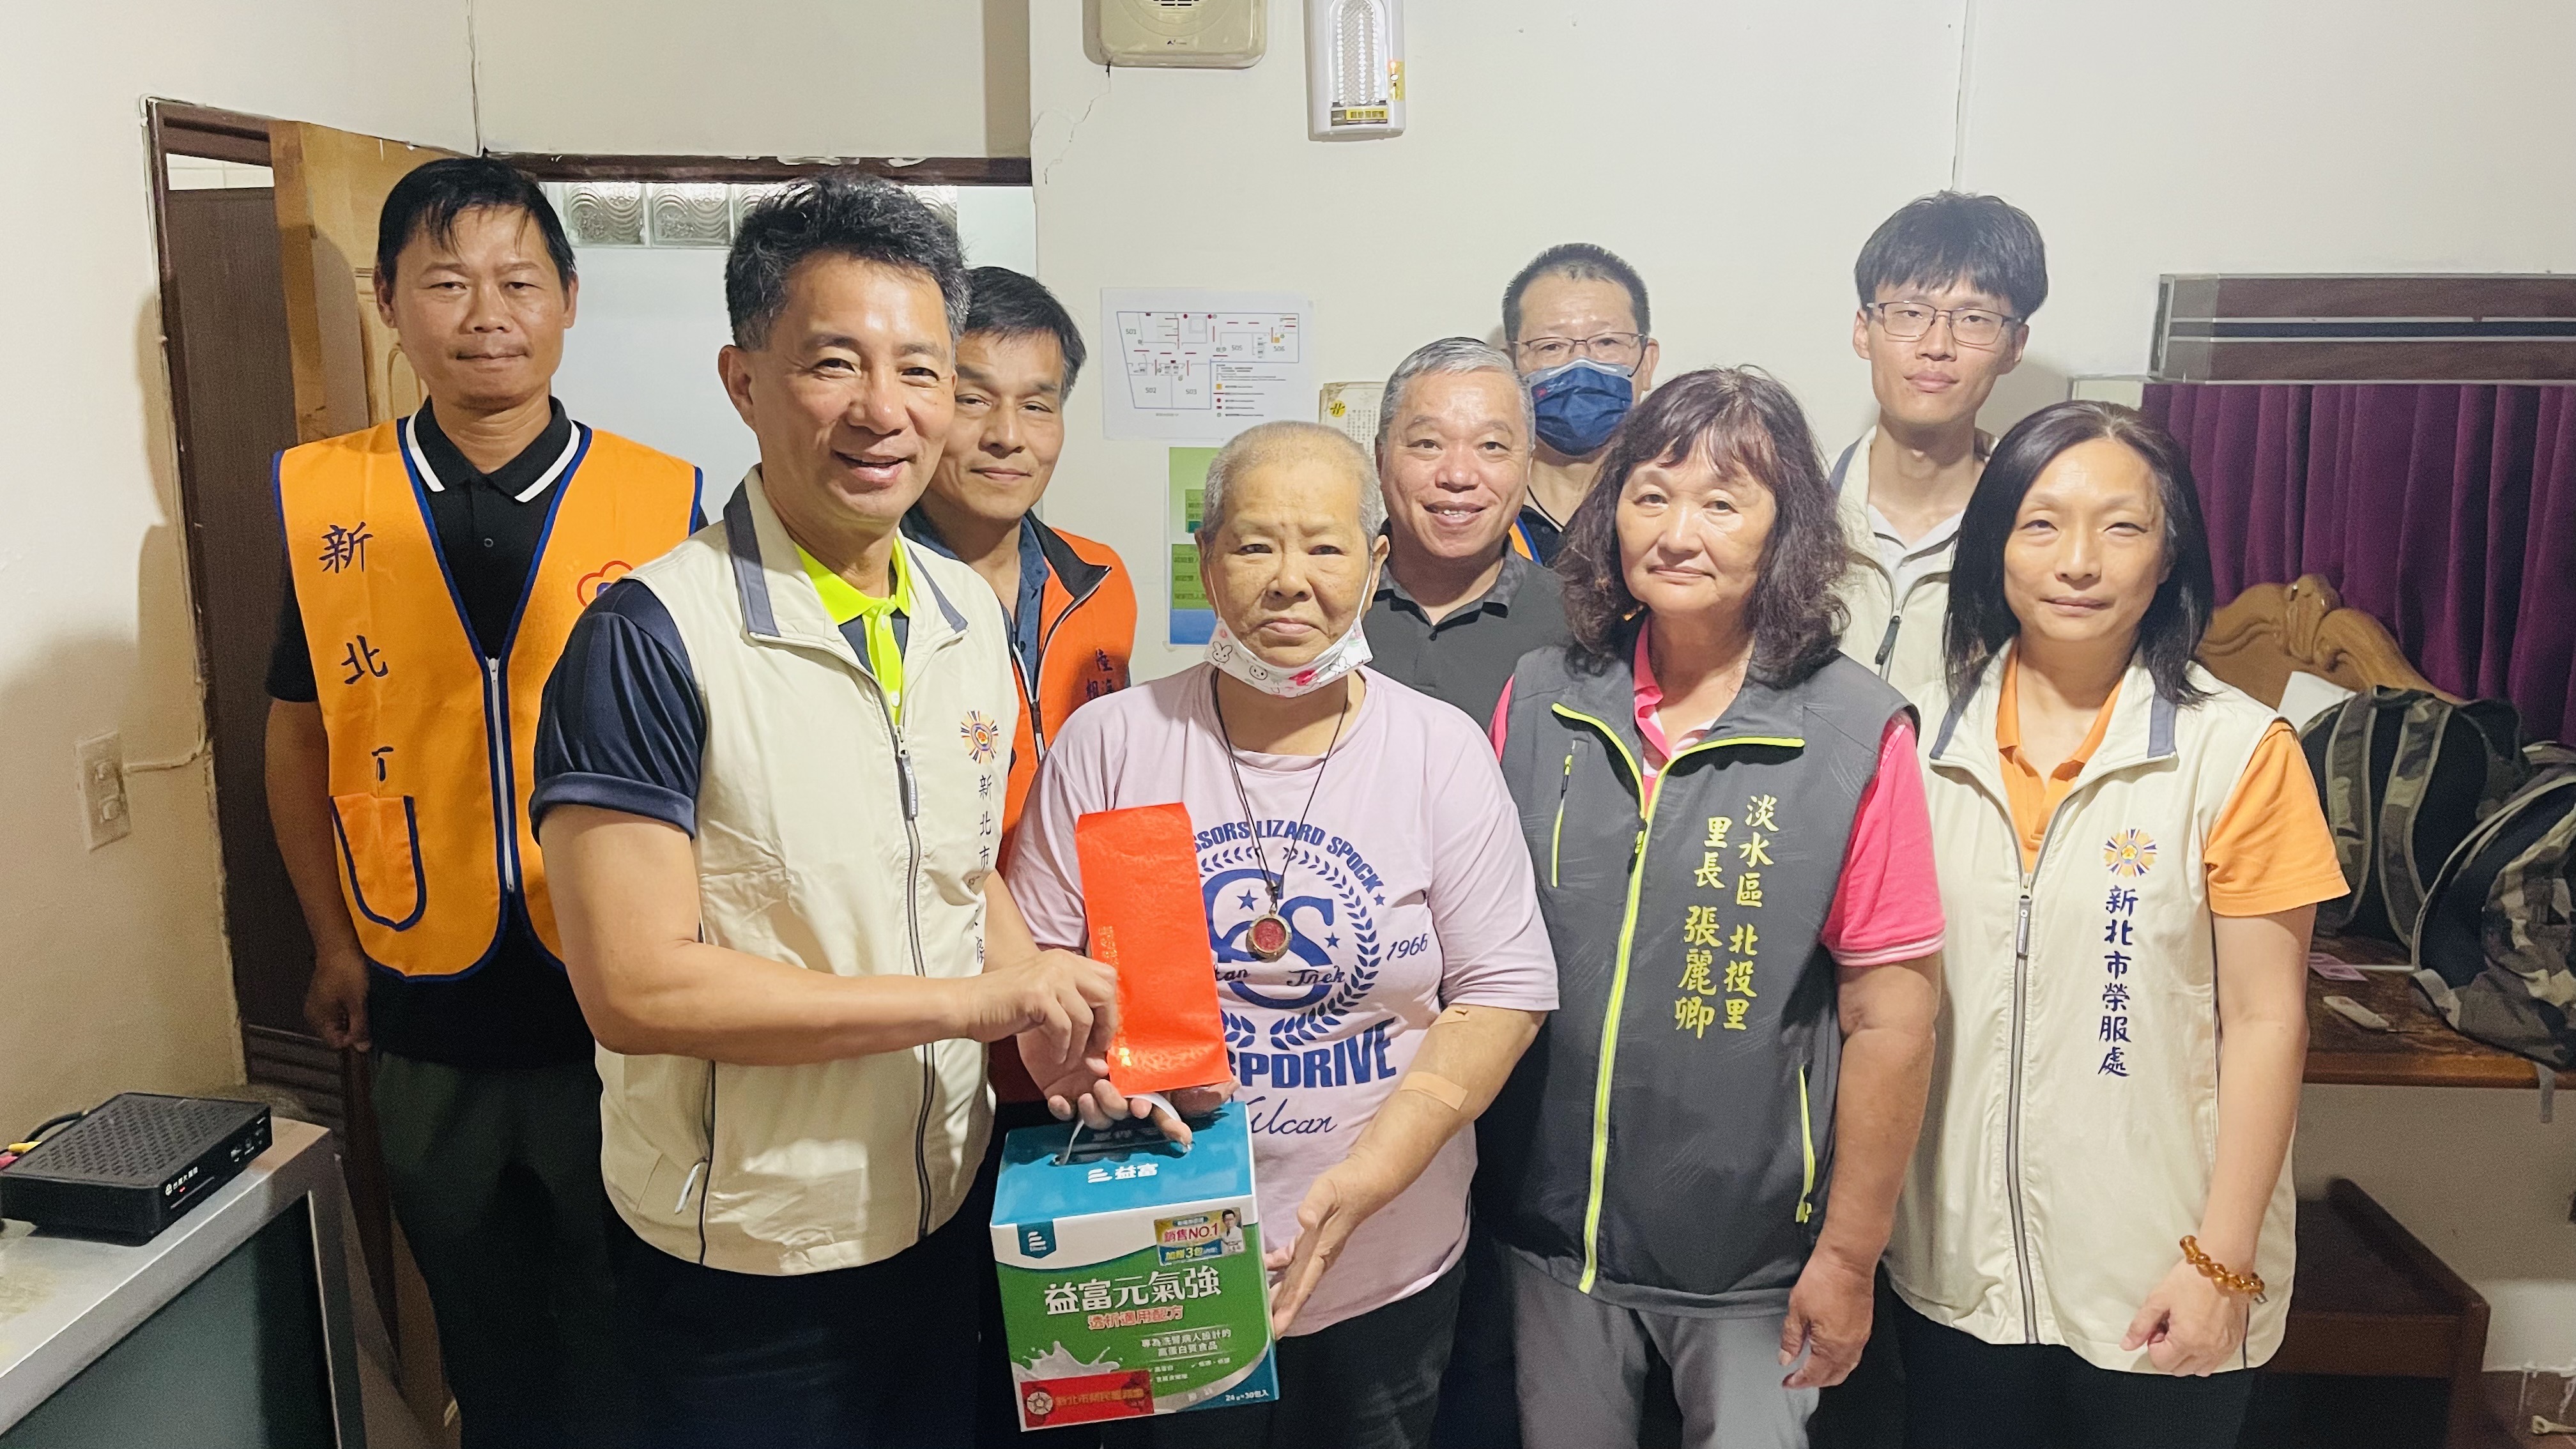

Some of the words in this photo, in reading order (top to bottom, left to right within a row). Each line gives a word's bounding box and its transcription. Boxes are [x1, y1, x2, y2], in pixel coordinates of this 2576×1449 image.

[1257, 820, 1326, 847] LIZARD
[1326, 836, 1384, 894] SPOCK
[1694, 816, 1732, 889] 里長
[1735, 794, 1779, 908] 淡水區
[1386, 933, 1429, 961] 1966
[1675, 905, 1722, 1039] 張麗卿
[1722, 924, 1758, 1031] 北投里
[2097, 885, 2139, 1077] 新北市榮服處
[1227, 1016, 1397, 1089] PDRIVE
[1114, 1163, 1159, 1180] 益富
[1044, 1265, 1222, 1315] 益富元氣強
[1087, 1305, 1184, 1330] 透析適用配方
